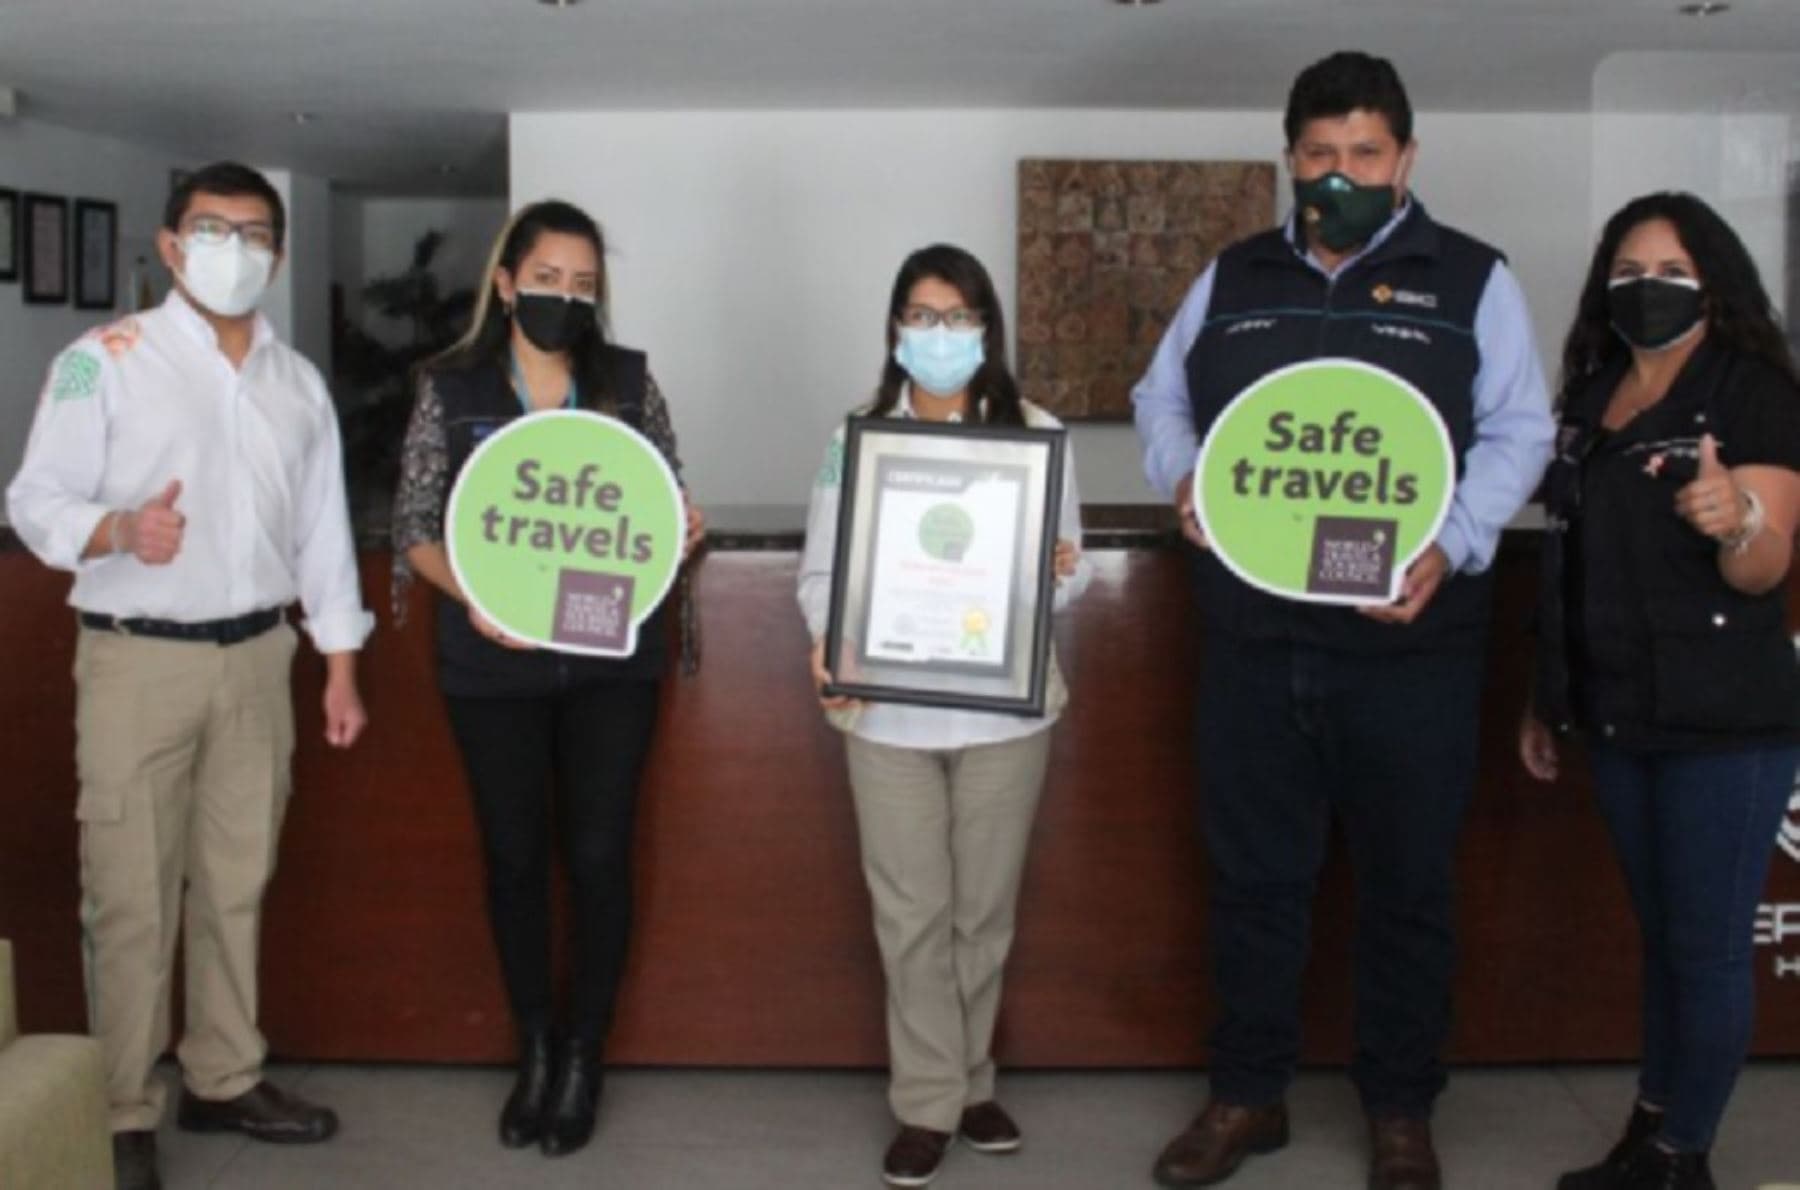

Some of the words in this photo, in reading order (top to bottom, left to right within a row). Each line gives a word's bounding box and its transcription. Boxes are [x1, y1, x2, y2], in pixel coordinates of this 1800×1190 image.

[1264, 410, 1383, 457] Safe
[513, 458, 624, 513] Safe
[1231, 457, 1419, 506] travels
[481, 504, 654, 564] travels
